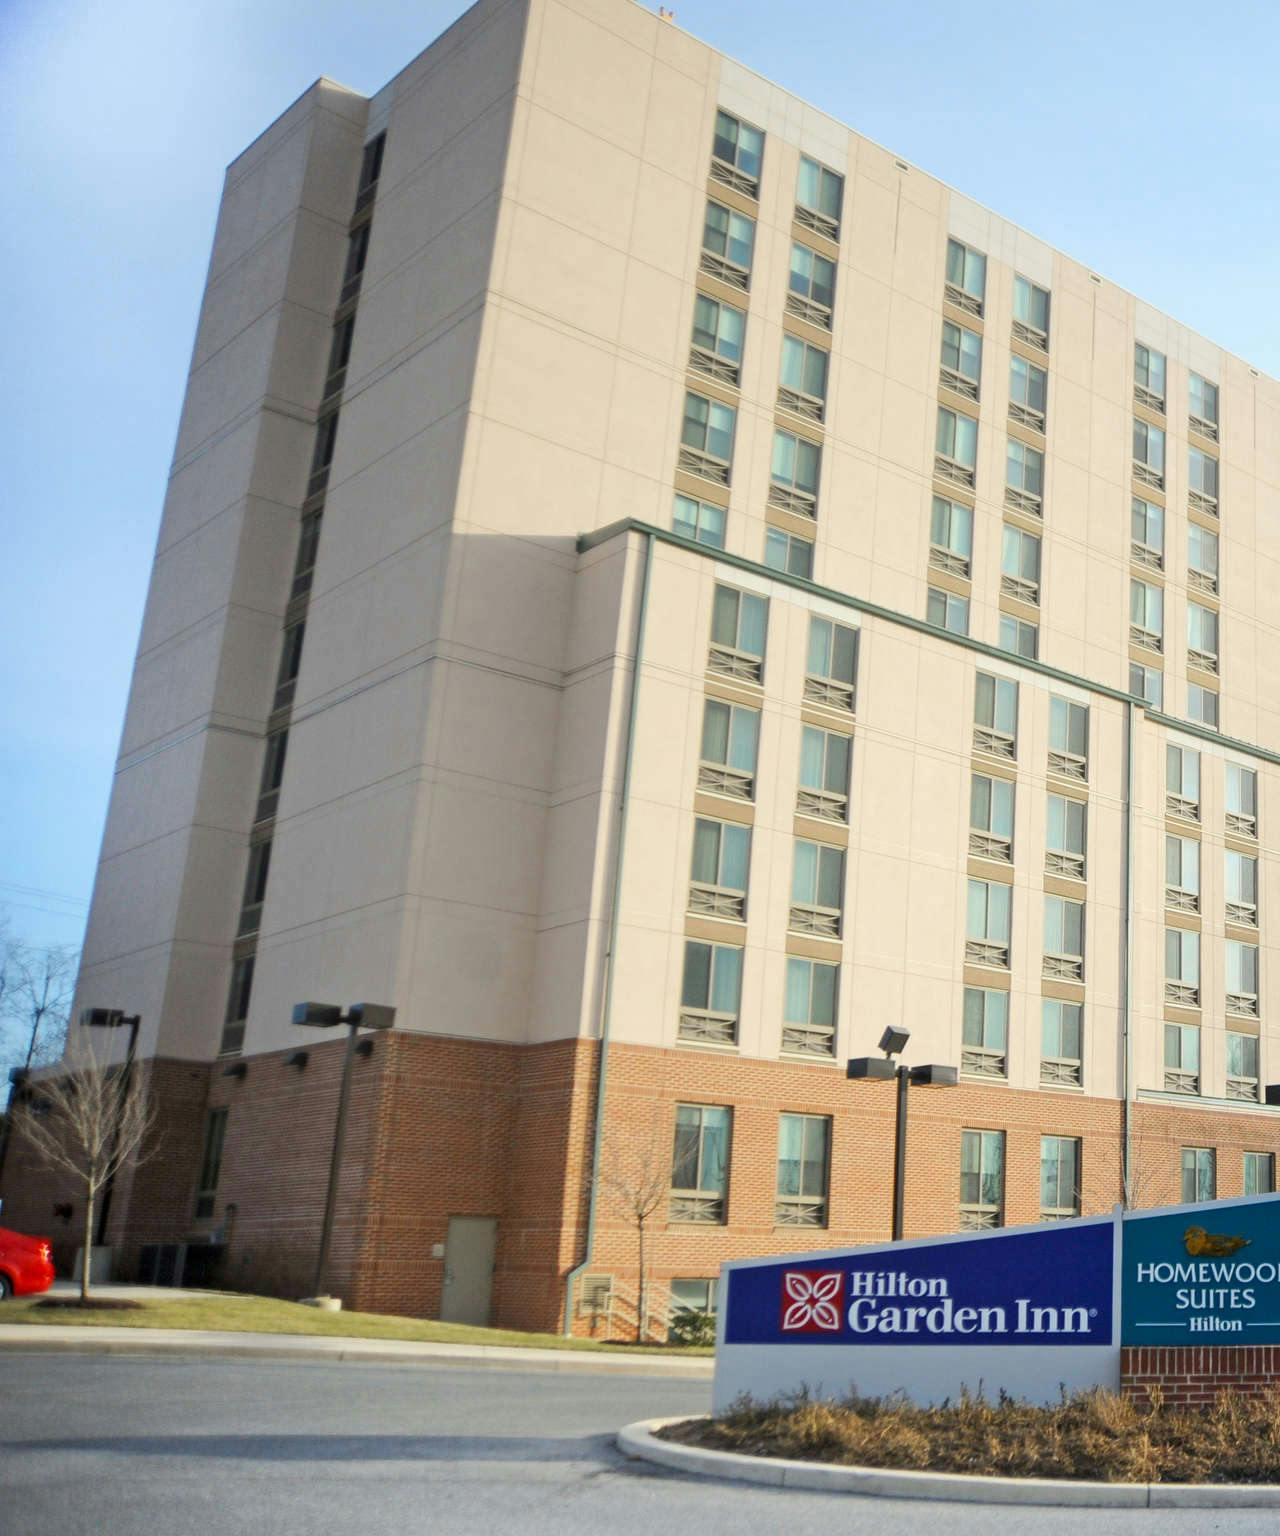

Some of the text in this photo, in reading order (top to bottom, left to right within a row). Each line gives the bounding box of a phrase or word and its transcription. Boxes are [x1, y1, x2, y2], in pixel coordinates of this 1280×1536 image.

[850, 1271, 949, 1297] Hilton
[1175, 1288, 1256, 1309] SUITES
[848, 1298, 1009, 1334] Garden
[1189, 1315, 1243, 1332] Hilton
